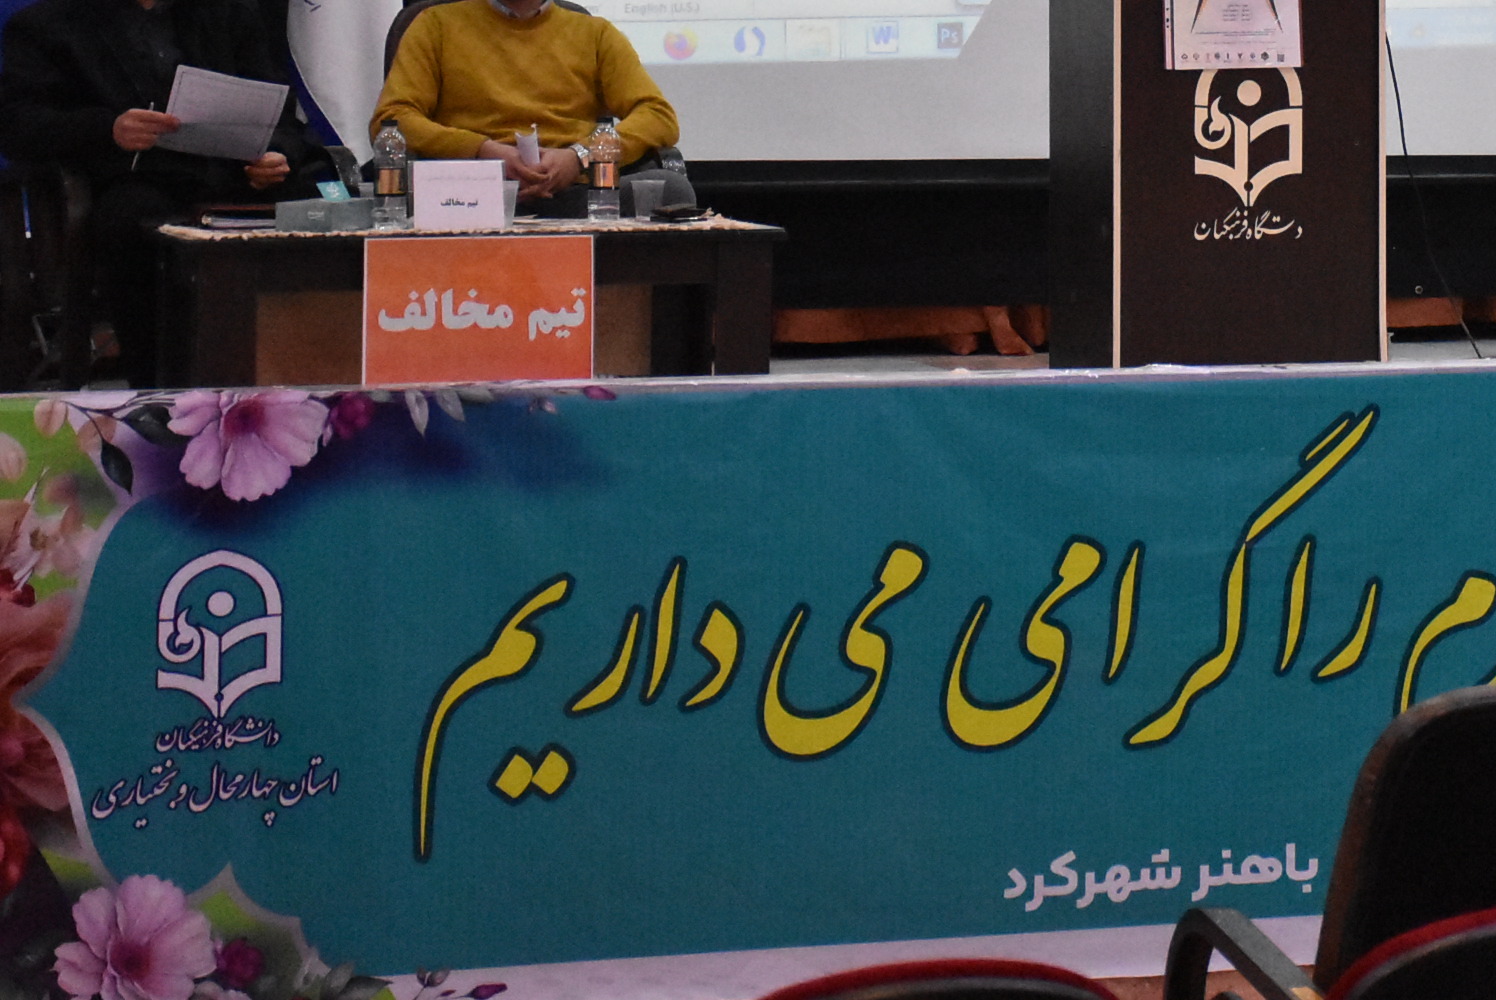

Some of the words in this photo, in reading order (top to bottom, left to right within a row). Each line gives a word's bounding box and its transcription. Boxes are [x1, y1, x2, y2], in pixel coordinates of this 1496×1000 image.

[623, 2, 668, 17] English
[871, 24, 893, 45] W
[938, 28, 960, 47] Ps
[377, 286, 515, 333] مخالف
[527, 286, 588, 342] تیم
[1276, 534, 1382, 680] را
[156, 718, 222, 751] فرهنگیان
[214, 717, 281, 749] دانشگاه
[91, 758, 179, 829] بختیاری
[278, 756, 340, 806] استان
[1002, 848, 1183, 912] شهرکرد
[1192, 842, 1320, 904] باهنر
